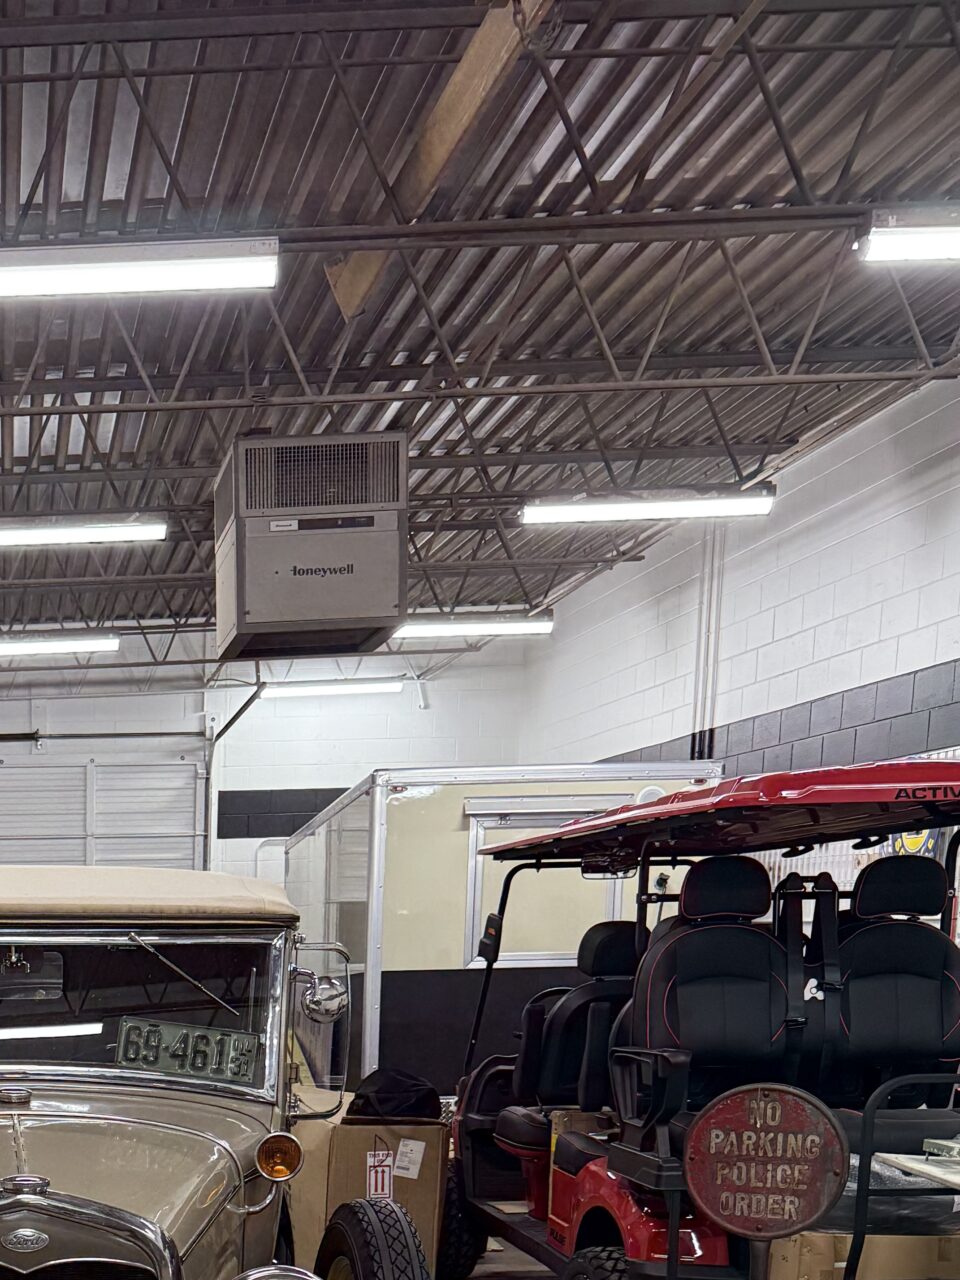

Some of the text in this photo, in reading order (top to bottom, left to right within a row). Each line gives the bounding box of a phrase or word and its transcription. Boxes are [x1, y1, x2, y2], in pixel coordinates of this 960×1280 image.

[289, 563, 354, 578] Honeywell
[123, 1023, 227, 1076] 69-461
[749, 1099, 782, 1127] NO
[709, 1129, 821, 1160] PARKING
[716, 1161, 810, 1191] POLICE
[719, 1191, 801, 1221] ORDER
[8, 1233, 43, 1247] Ford
